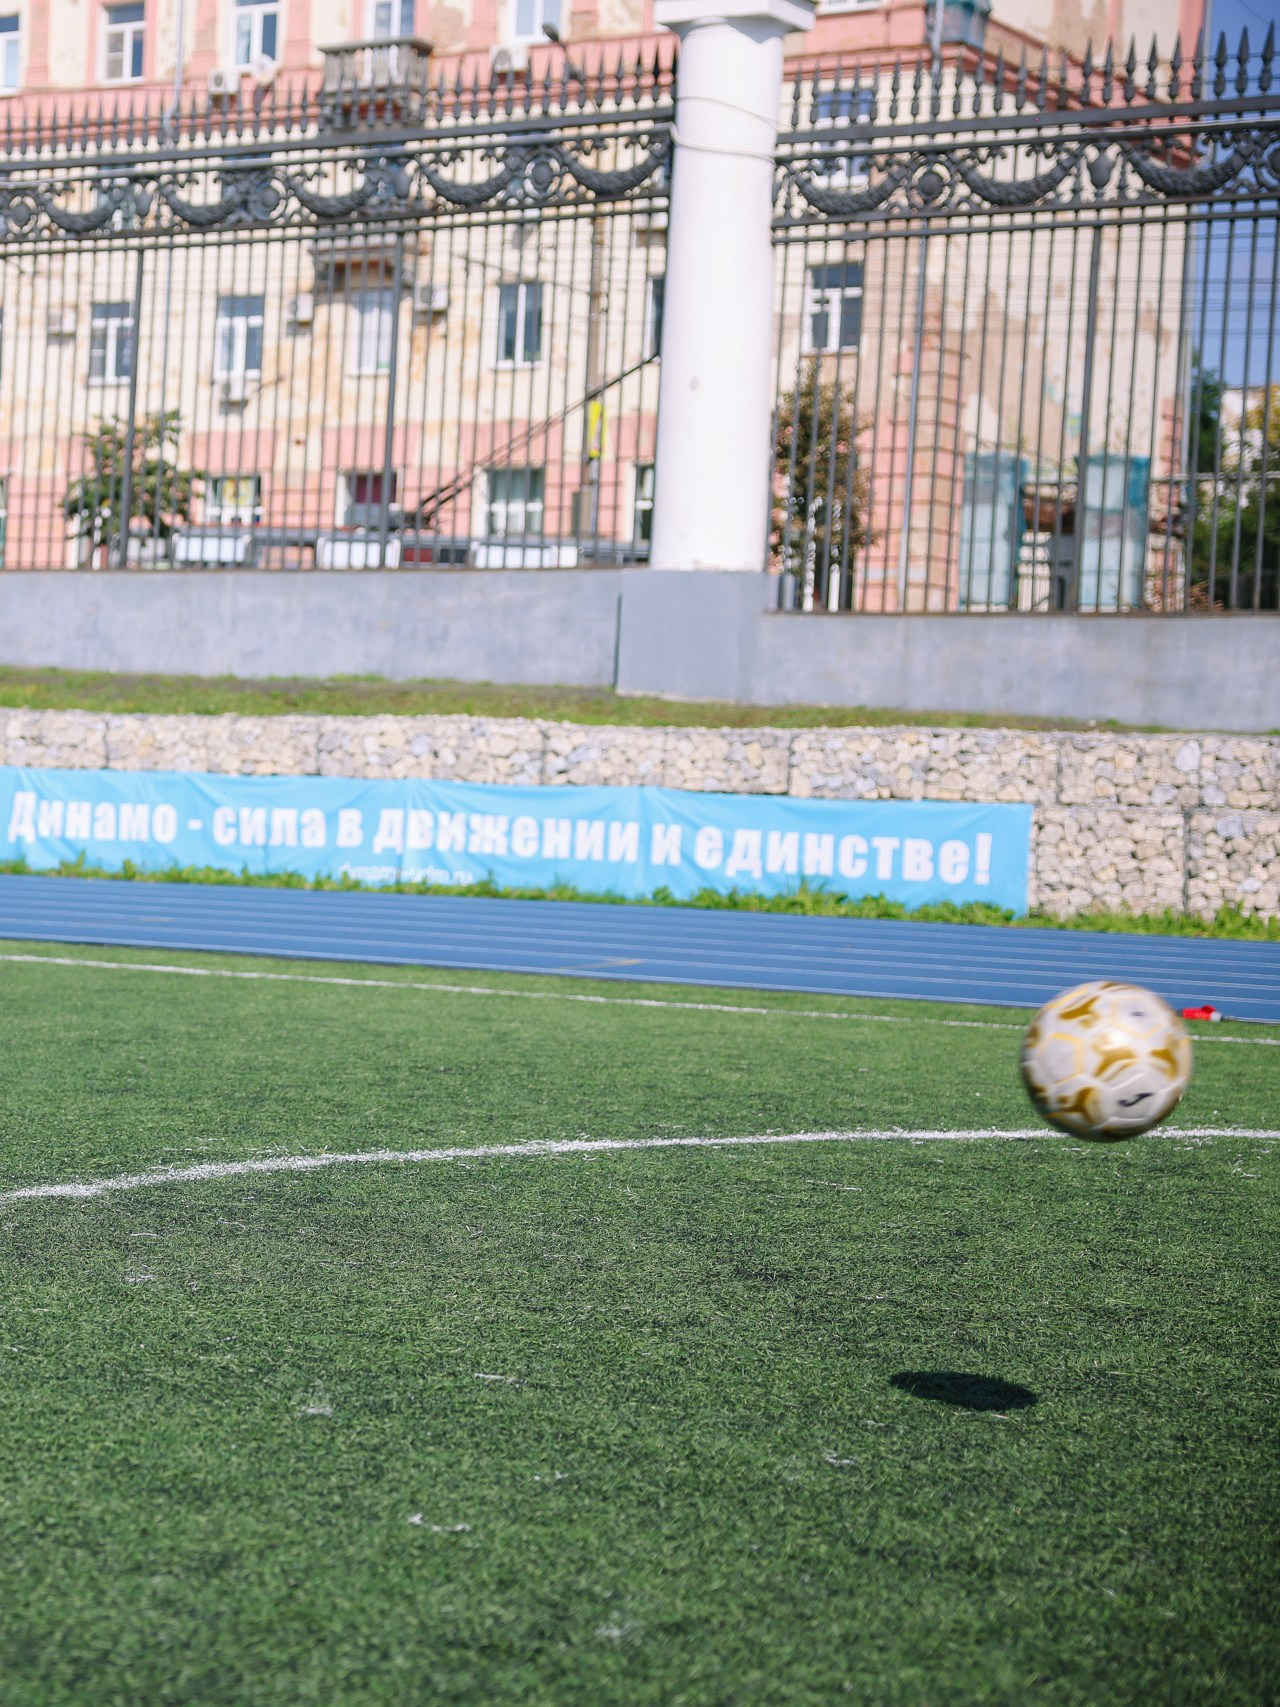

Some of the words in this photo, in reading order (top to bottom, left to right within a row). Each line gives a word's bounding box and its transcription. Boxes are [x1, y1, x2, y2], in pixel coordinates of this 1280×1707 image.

[9, 792, 177, 844] Динамо
[187, 818, 204, 831] -
[214, 807, 325, 847] сила
[336, 809, 362, 847] в
[373, 809, 639, 862] движении
[652, 824, 681, 864] и
[695, 827, 992, 885] единстве!
